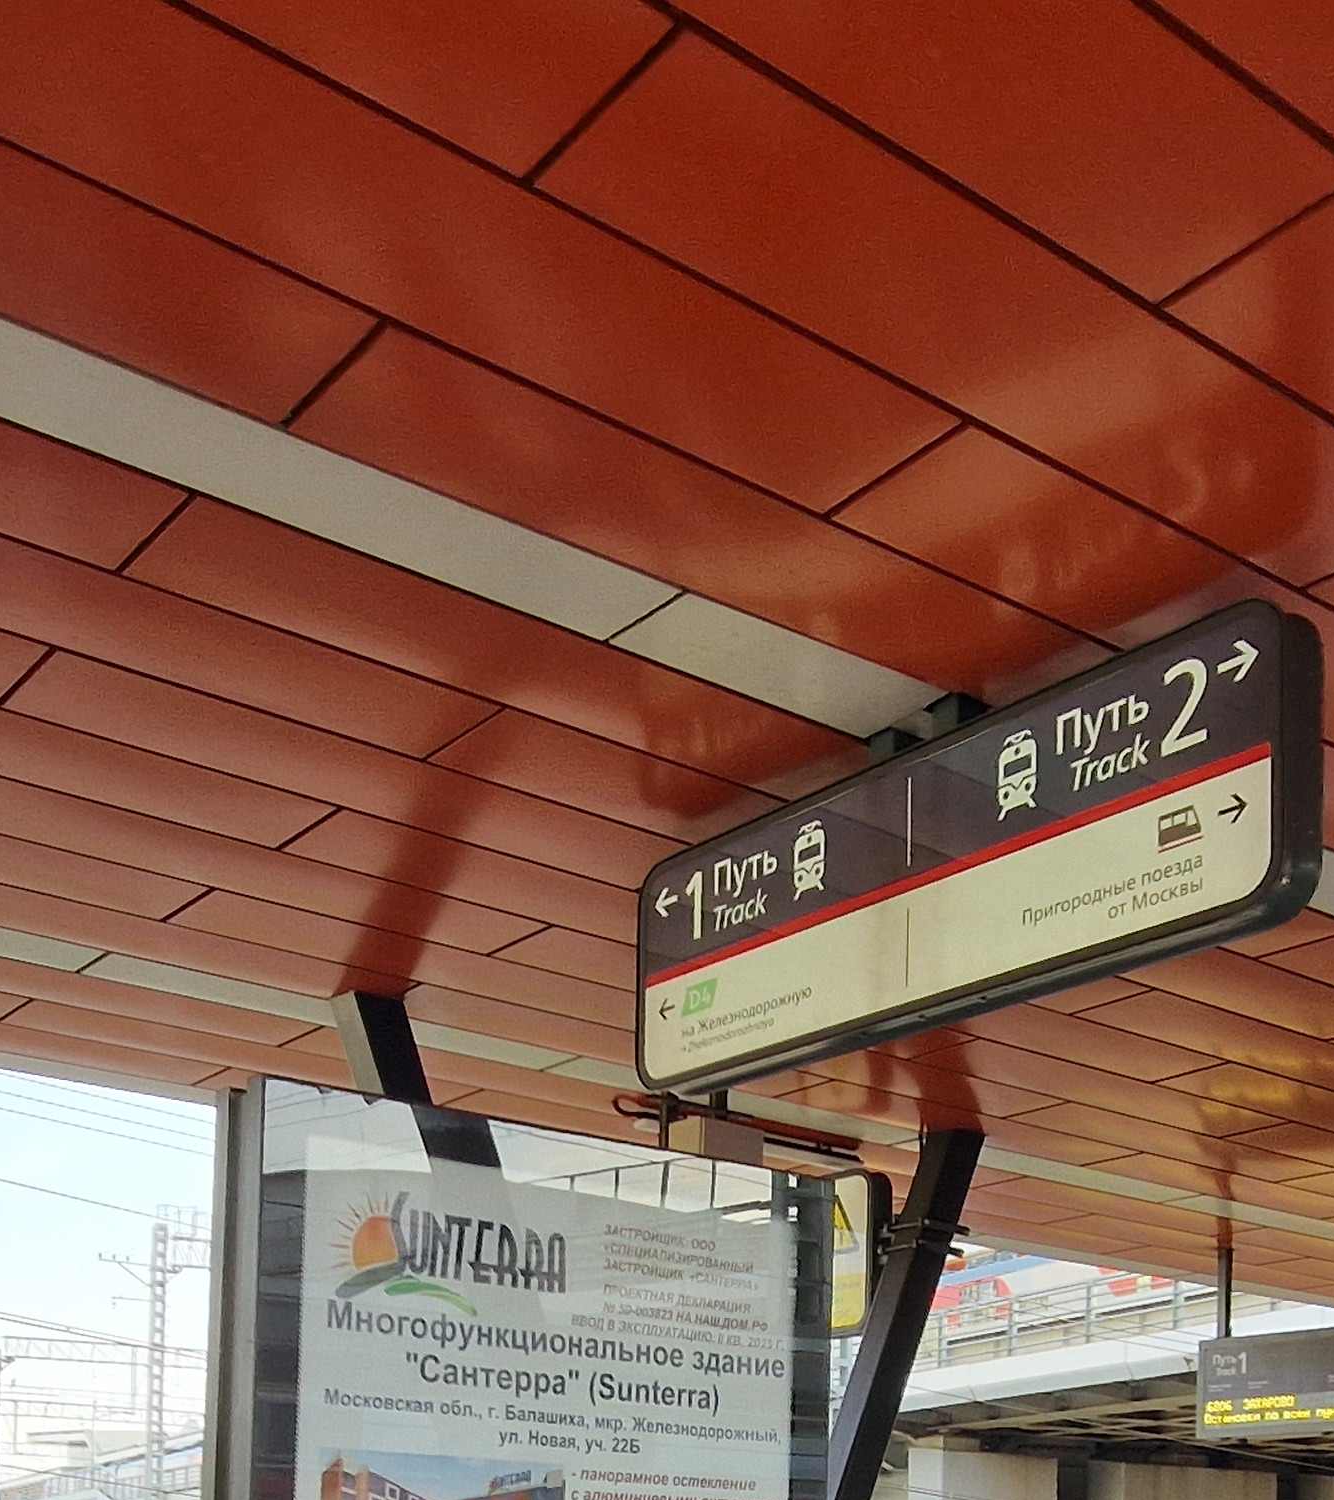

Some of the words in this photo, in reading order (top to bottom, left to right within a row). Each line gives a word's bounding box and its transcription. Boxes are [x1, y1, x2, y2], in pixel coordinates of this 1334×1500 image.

[1055, 694, 1150, 755] Путь
[1160, 658, 1208, 757] 2
[1070, 732, 1150, 791] Track
[685, 871, 703, 940] 1
[713, 849, 778, 898] Путь
[712, 888, 769, 932] Track
[1021, 878, 1136, 926] Пригородные
[1141, 854, 1203, 885] поезда
[1107, 902, 1127, 920] от
[1132, 878, 1203, 912] Москвы
[682, 1026, 695, 1037] на
[698, 986, 812, 1032] Железнодорожную
[689, 986, 712, 1010] D4
[385, 1192, 566, 1294] SUNTERRA
[691, 1238, 716, 1252] ООО
[327, 1299, 683, 1366] Многофункциональное
[692, 1350, 785, 1378] здание
[406, 1352, 580, 1398] "Сантерра"
[589, 1371, 720, 1417] (Sunterra)
[1238, 1352, 1247, 1374] 1
[324, 1388, 434, 1414] Московская
[440, 1400, 482, 1420] обл.,
[488, 1406, 499, 1420] г.
[505, 1405, 589, 1430] Балашиха,
[594, 1416, 626, 1433] мкр.
[632, 1416, 781, 1445] Железнодорожный,
[1264, 1411, 1280, 1421] по
[499, 1431, 523, 1447] ул.
[528, 1430, 580, 1452] Новая,
[585, 1439, 607, 1454] уч.
[611, 1437, 641, 1454] 22Б
[571, 1490, 579, 1500] с
[580, 1469, 669, 1486] панорамное
[673, 1474, 757, 1491] остекление
